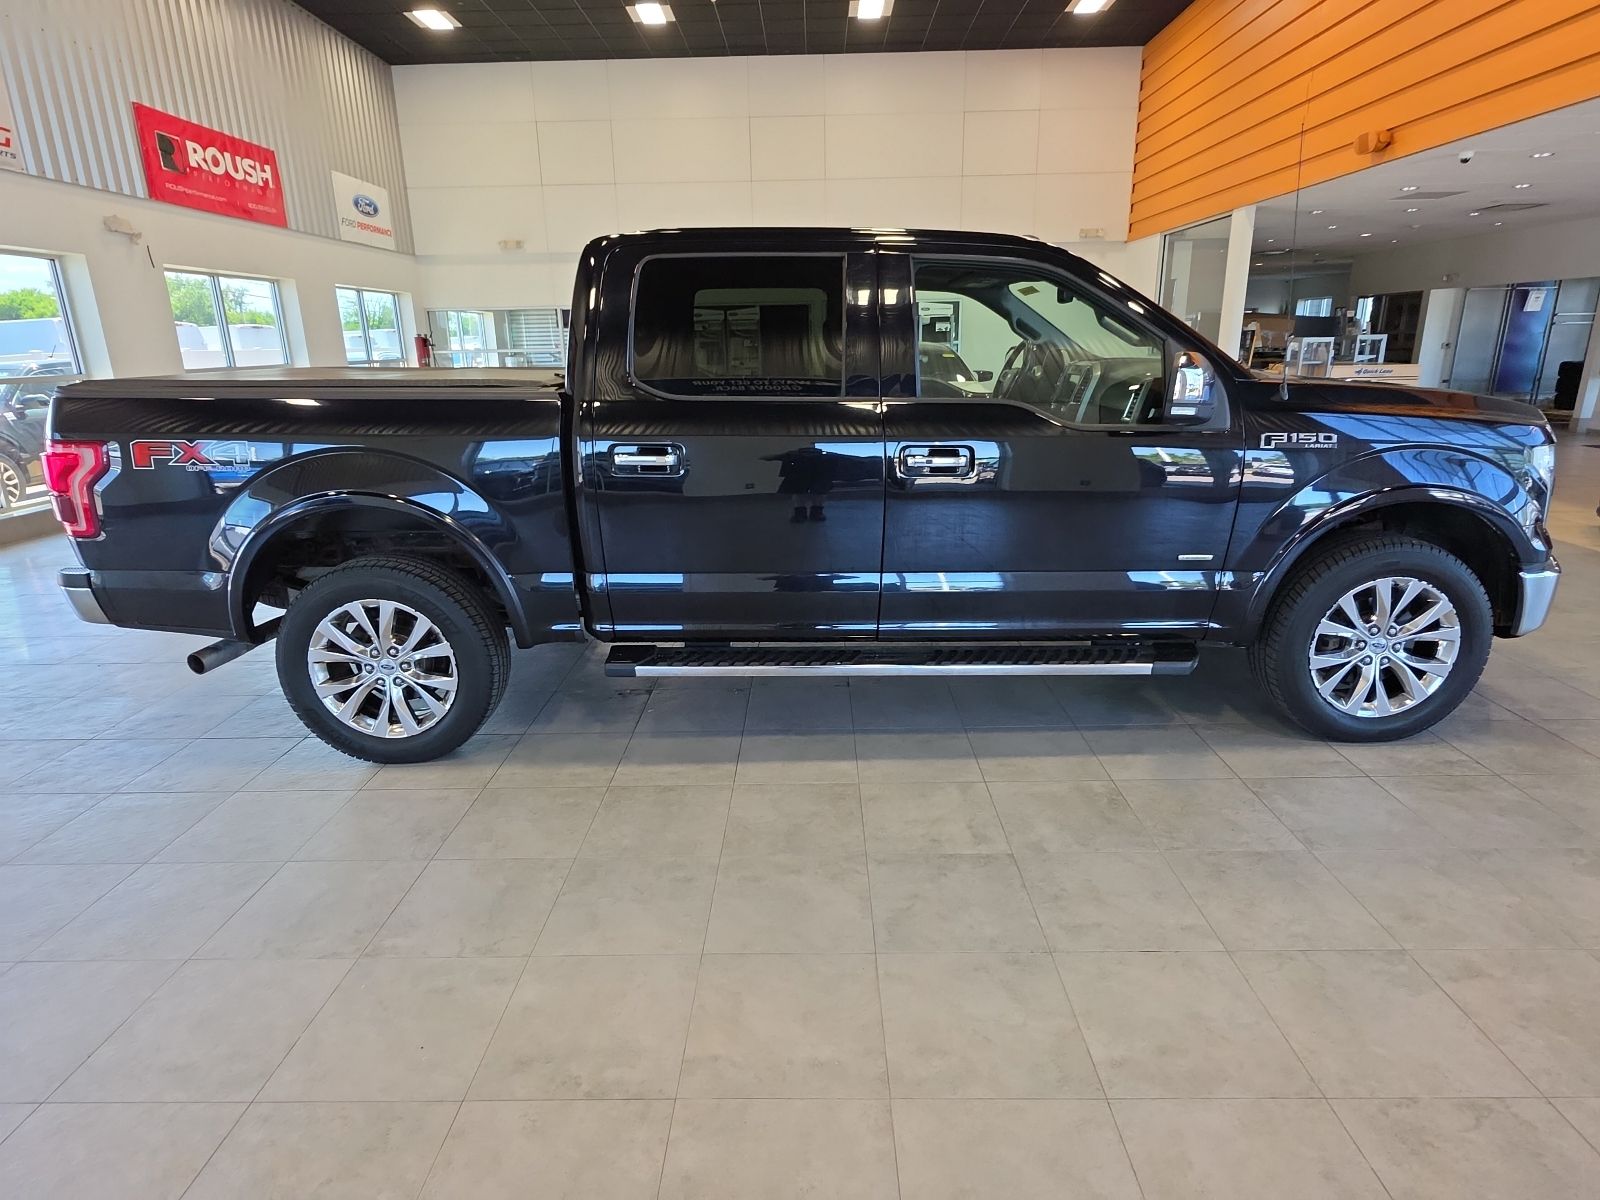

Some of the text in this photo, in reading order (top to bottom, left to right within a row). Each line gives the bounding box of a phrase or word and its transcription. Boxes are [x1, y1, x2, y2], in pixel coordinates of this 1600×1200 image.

[185, 139, 273, 189] ROUSH
[341, 217, 357, 228] FORD
[1363, 367, 1394, 375] Quick Lane
[129, 439, 251, 470] FX4
